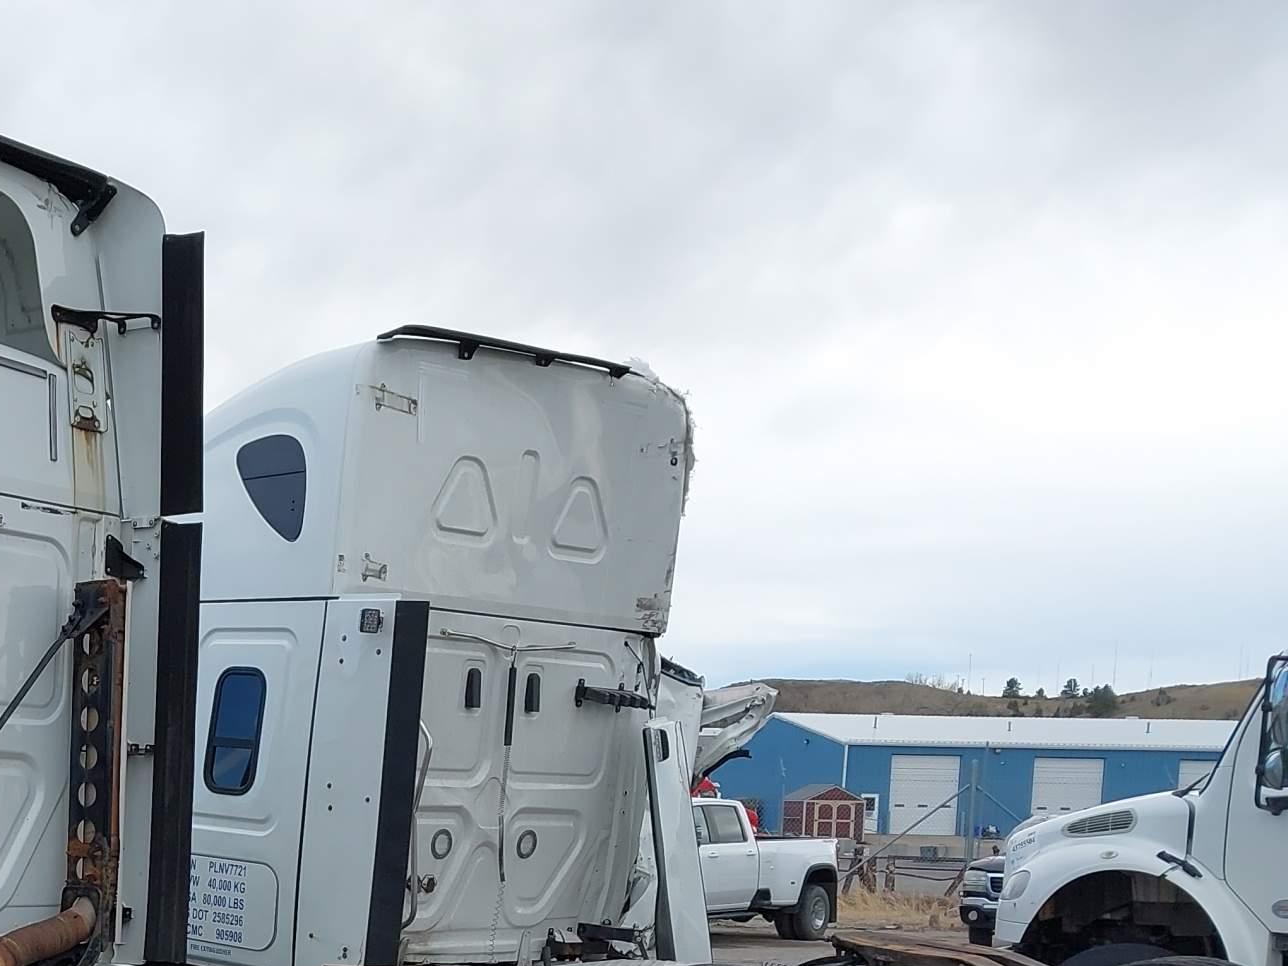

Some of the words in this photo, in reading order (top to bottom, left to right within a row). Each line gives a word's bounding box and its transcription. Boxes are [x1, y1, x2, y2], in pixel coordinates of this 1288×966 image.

[208, 861, 247, 878] PLNV7721
[208, 878, 232, 893] 40,000
[234, 882, 246, 894] KG
[202, 894, 226, 908] 80,000
[228, 896, 244, 911] LBS
[192, 908, 208, 922] DOT
[216, 928, 242, 944] 905908
